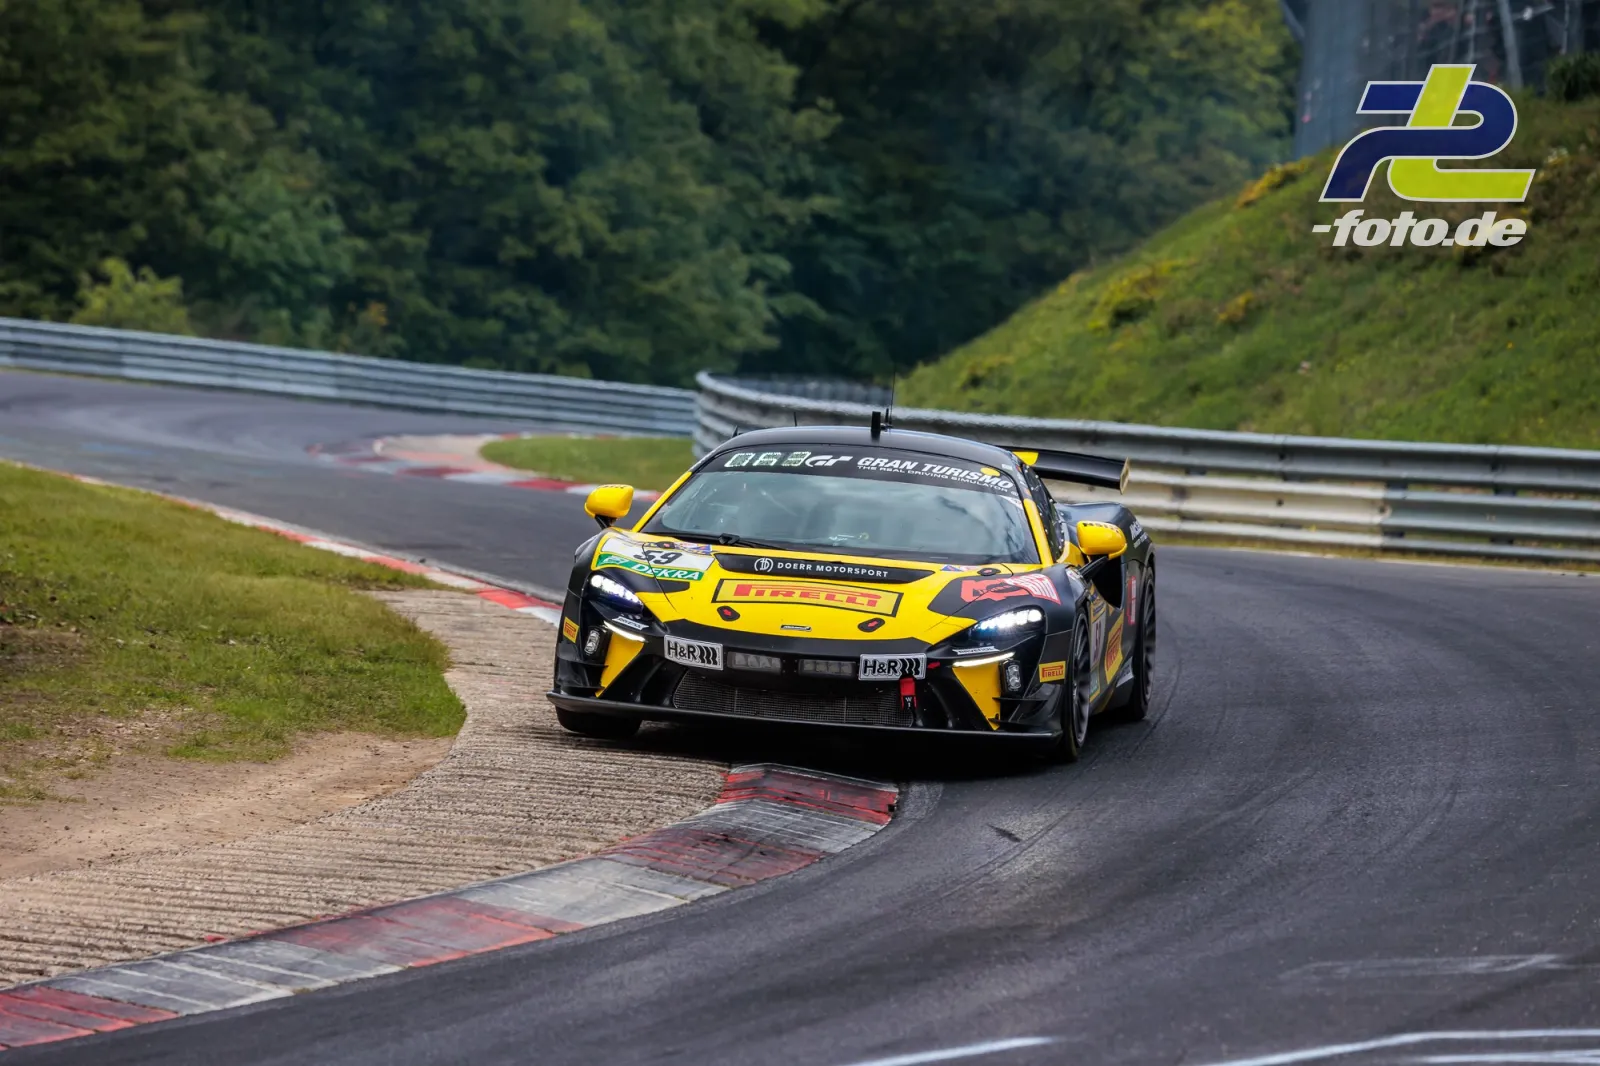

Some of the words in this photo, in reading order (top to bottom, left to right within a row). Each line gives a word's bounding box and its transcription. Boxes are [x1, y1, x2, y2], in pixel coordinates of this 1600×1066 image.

[857, 457, 918, 470] GRAN
[917, 463, 1014, 489] TURISMO
[907, 470, 949, 479] DRIVING
[951, 476, 1008, 493] SIMULATOR
[633, 549, 683, 565] 59
[632, 563, 700, 580] DEKRA
[777, 562, 812, 571] DOERR
[816, 564, 889, 578] MOTORSPORT
[733, 584, 882, 607] PIRELLI
[667, 640, 697, 661] H&R
[862, 659, 899, 676] H&R
[1042, 664, 1064, 679] PIRELLI
